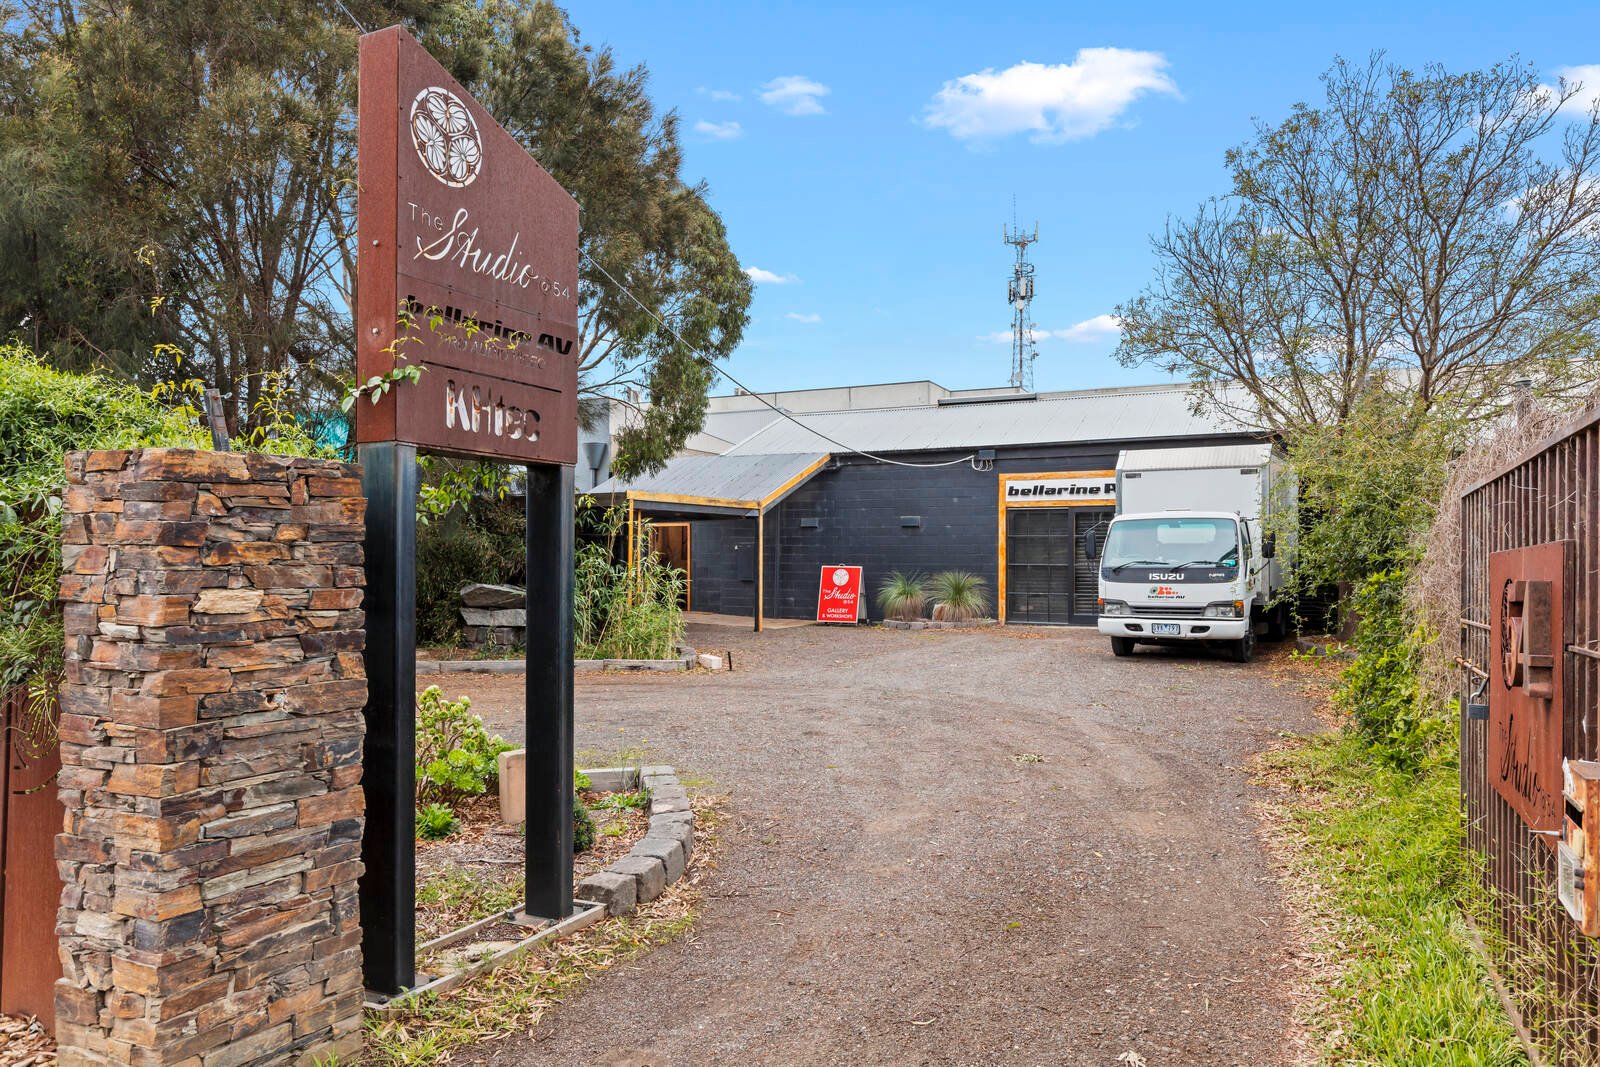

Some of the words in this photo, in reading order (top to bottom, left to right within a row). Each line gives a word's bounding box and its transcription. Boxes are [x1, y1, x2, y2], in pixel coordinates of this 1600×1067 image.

[408, 202, 443, 230] The
[413, 208, 538, 288] Studio
[538, 333, 573, 355] AV
[1007, 484, 1101, 496] bellarine
[824, 587, 856, 600] Studio
